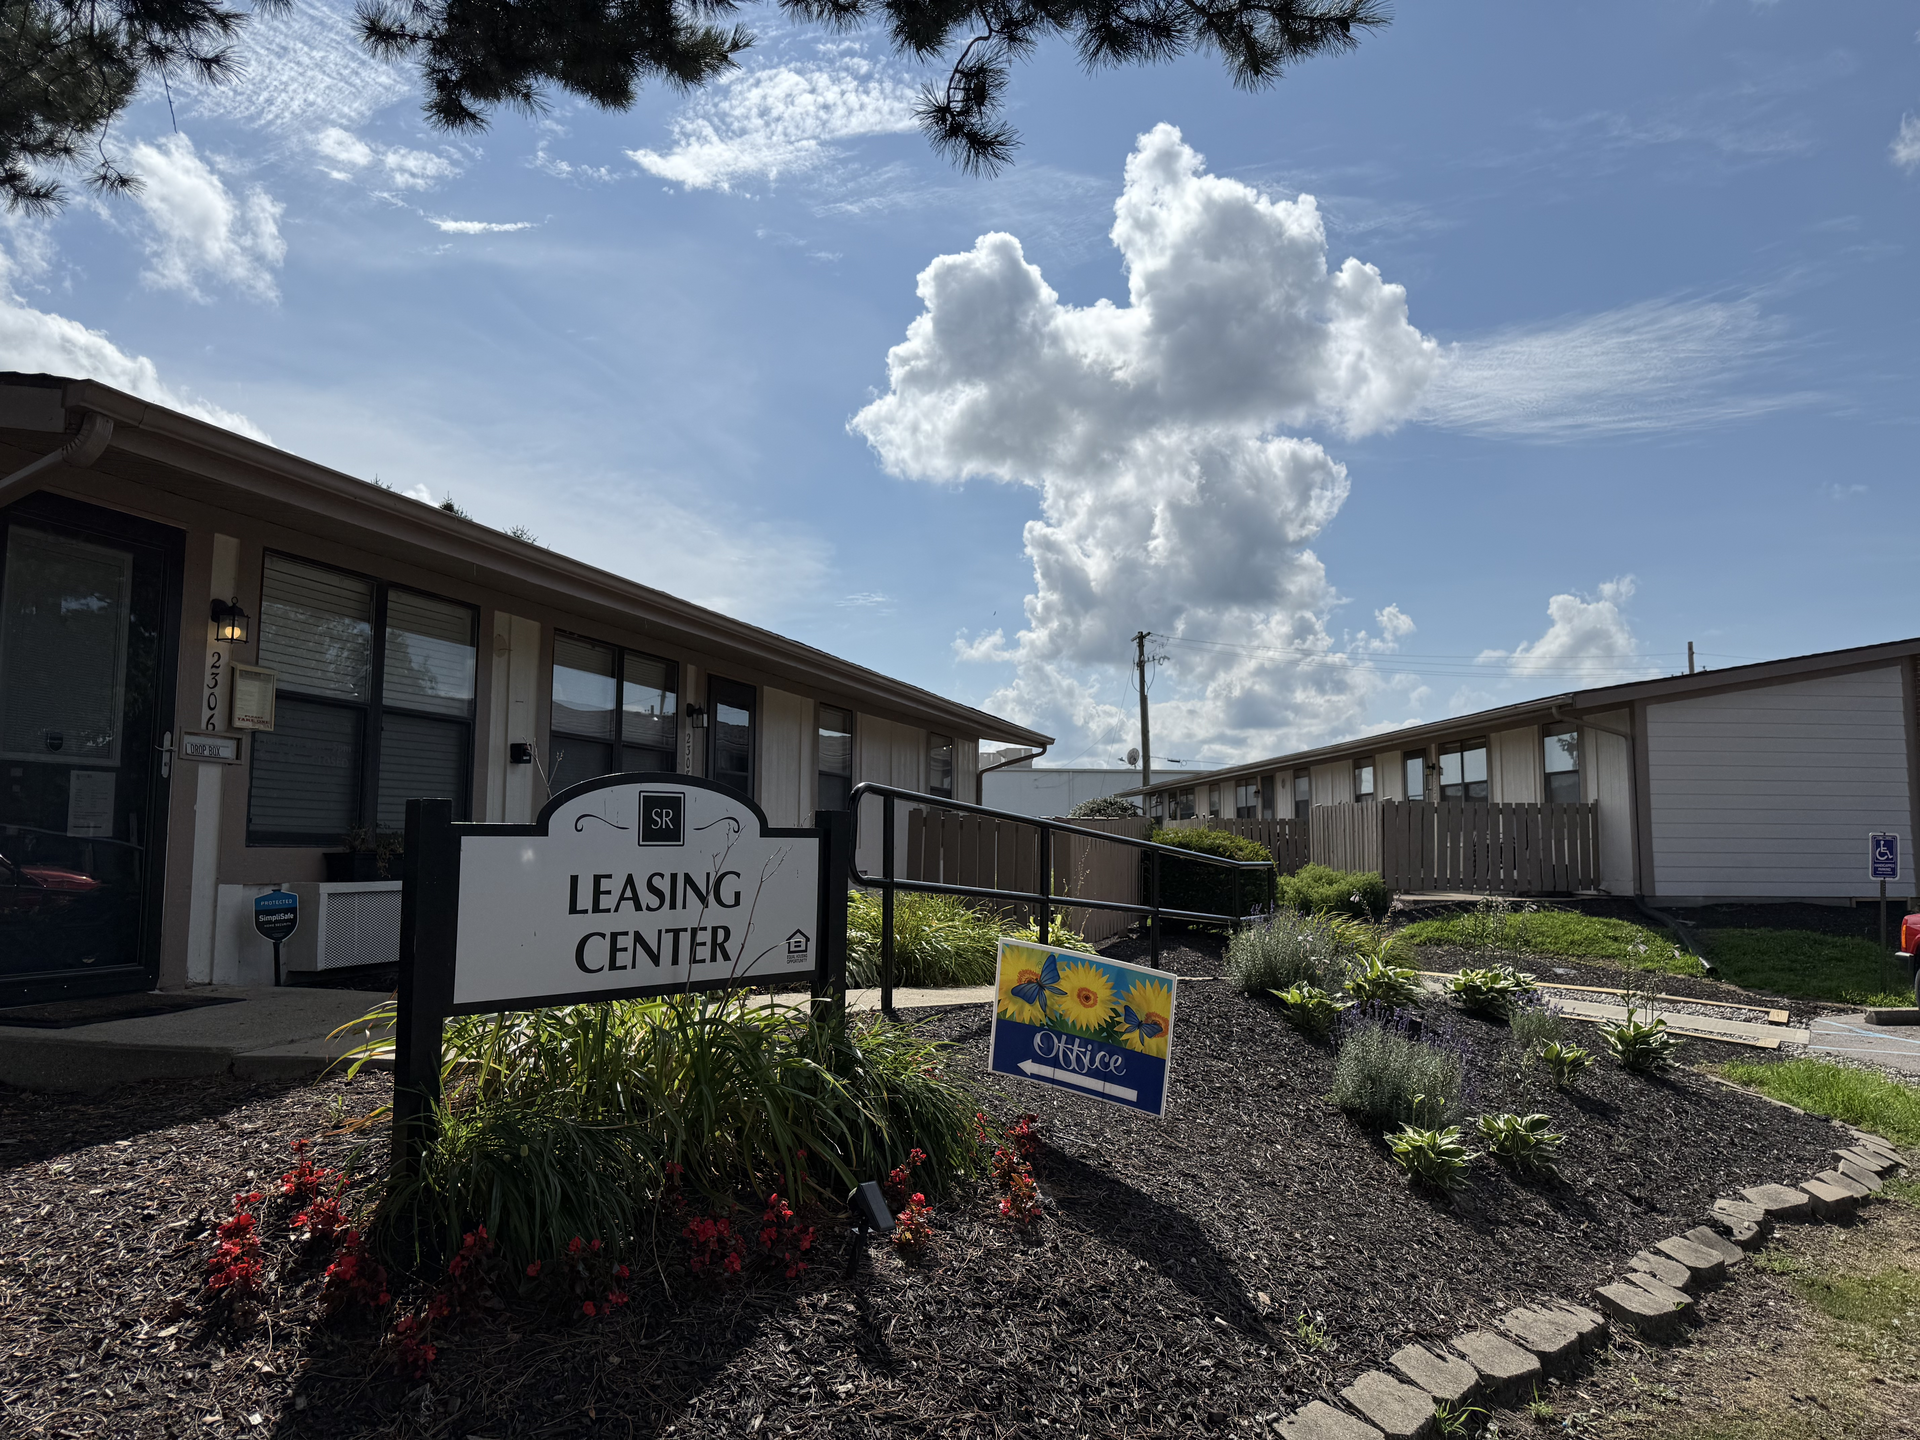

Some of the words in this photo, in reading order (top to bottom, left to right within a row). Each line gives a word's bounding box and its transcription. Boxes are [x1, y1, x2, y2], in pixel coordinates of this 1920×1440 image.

[206, 652, 221, 731] 2306
[190, 743, 207, 756] DROP
[208, 745, 221, 757] BOX
[651, 808, 674, 830] SR
[567, 870, 742, 915] LEASING
[259, 912, 294, 922] SimpliSafe
[574, 925, 732, 974] CENTER
[1033, 1030, 1127, 1076] Office
